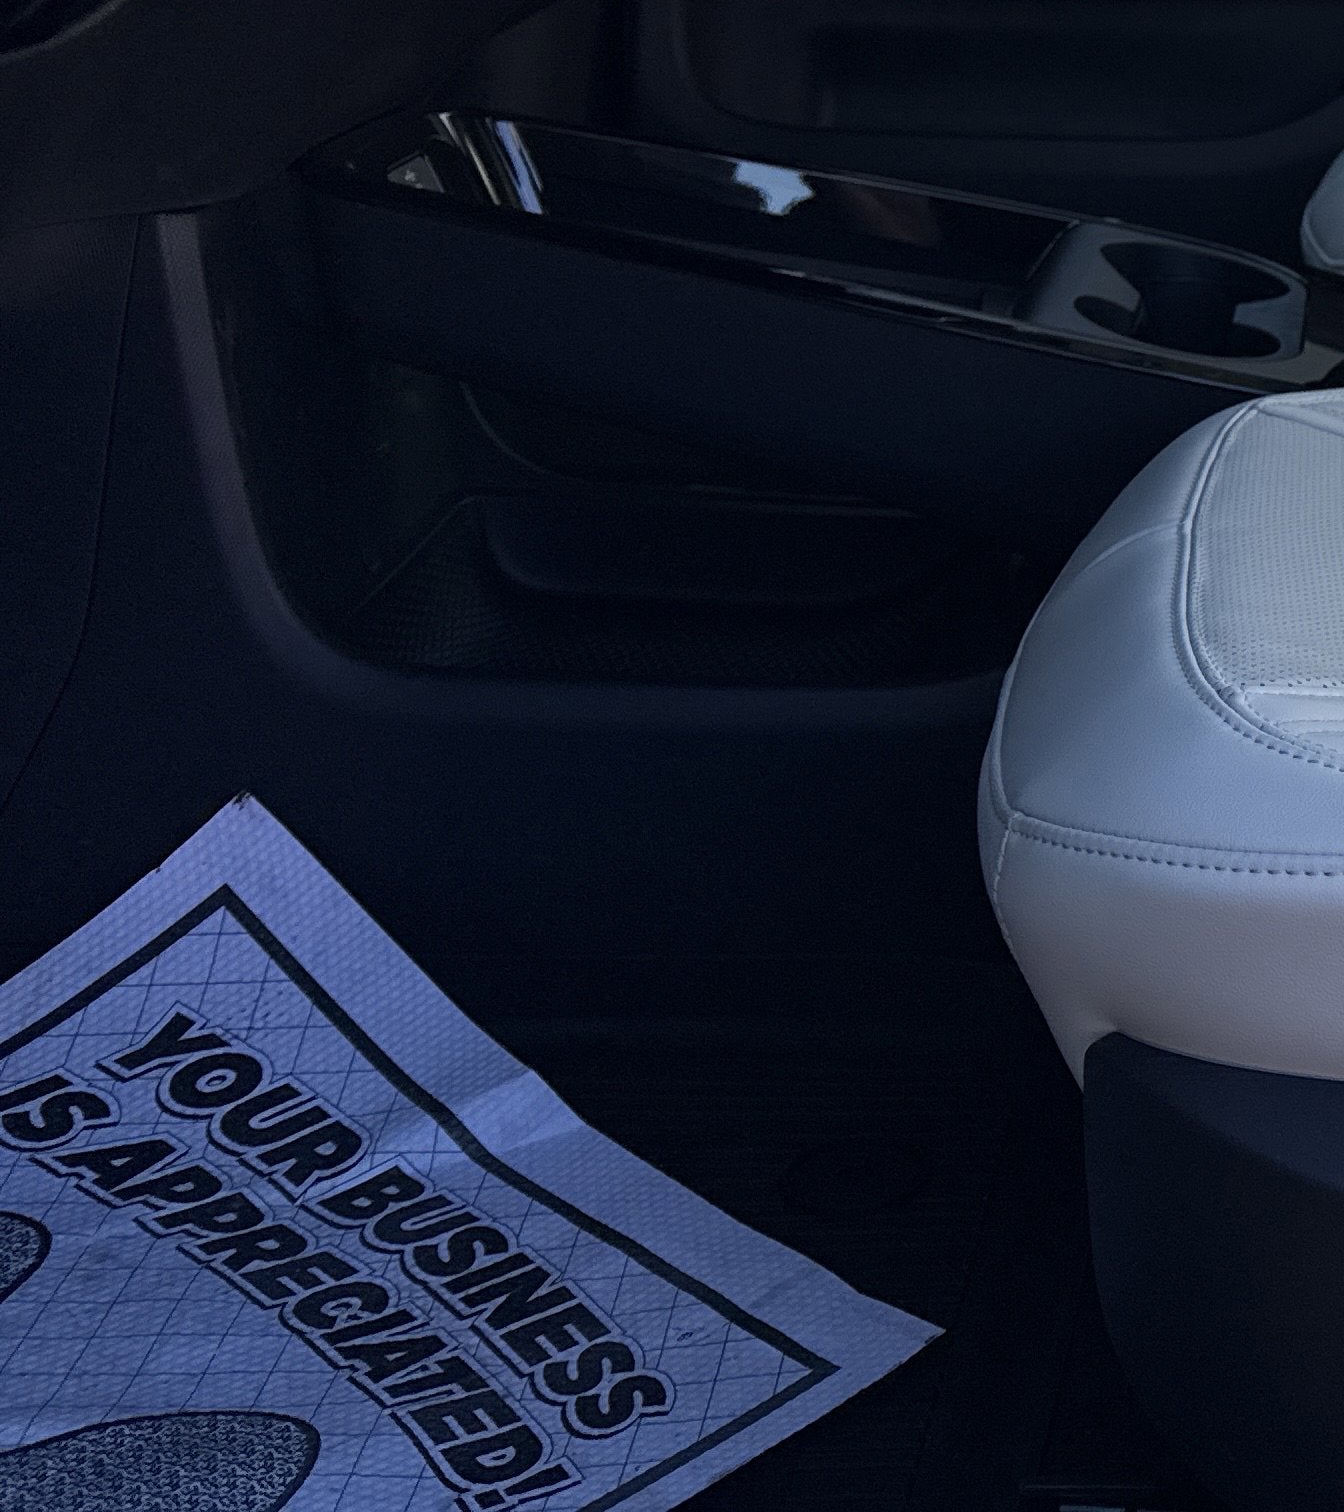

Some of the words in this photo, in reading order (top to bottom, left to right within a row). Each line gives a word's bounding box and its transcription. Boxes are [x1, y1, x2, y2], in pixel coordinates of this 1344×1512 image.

[0, 1068, 120, 1151] IS
[97, 1003, 370, 1204] YOUR
[302, 1158, 675, 1439] BUSINESS
[30, 1133, 583, 1512] APPRECIATED!
